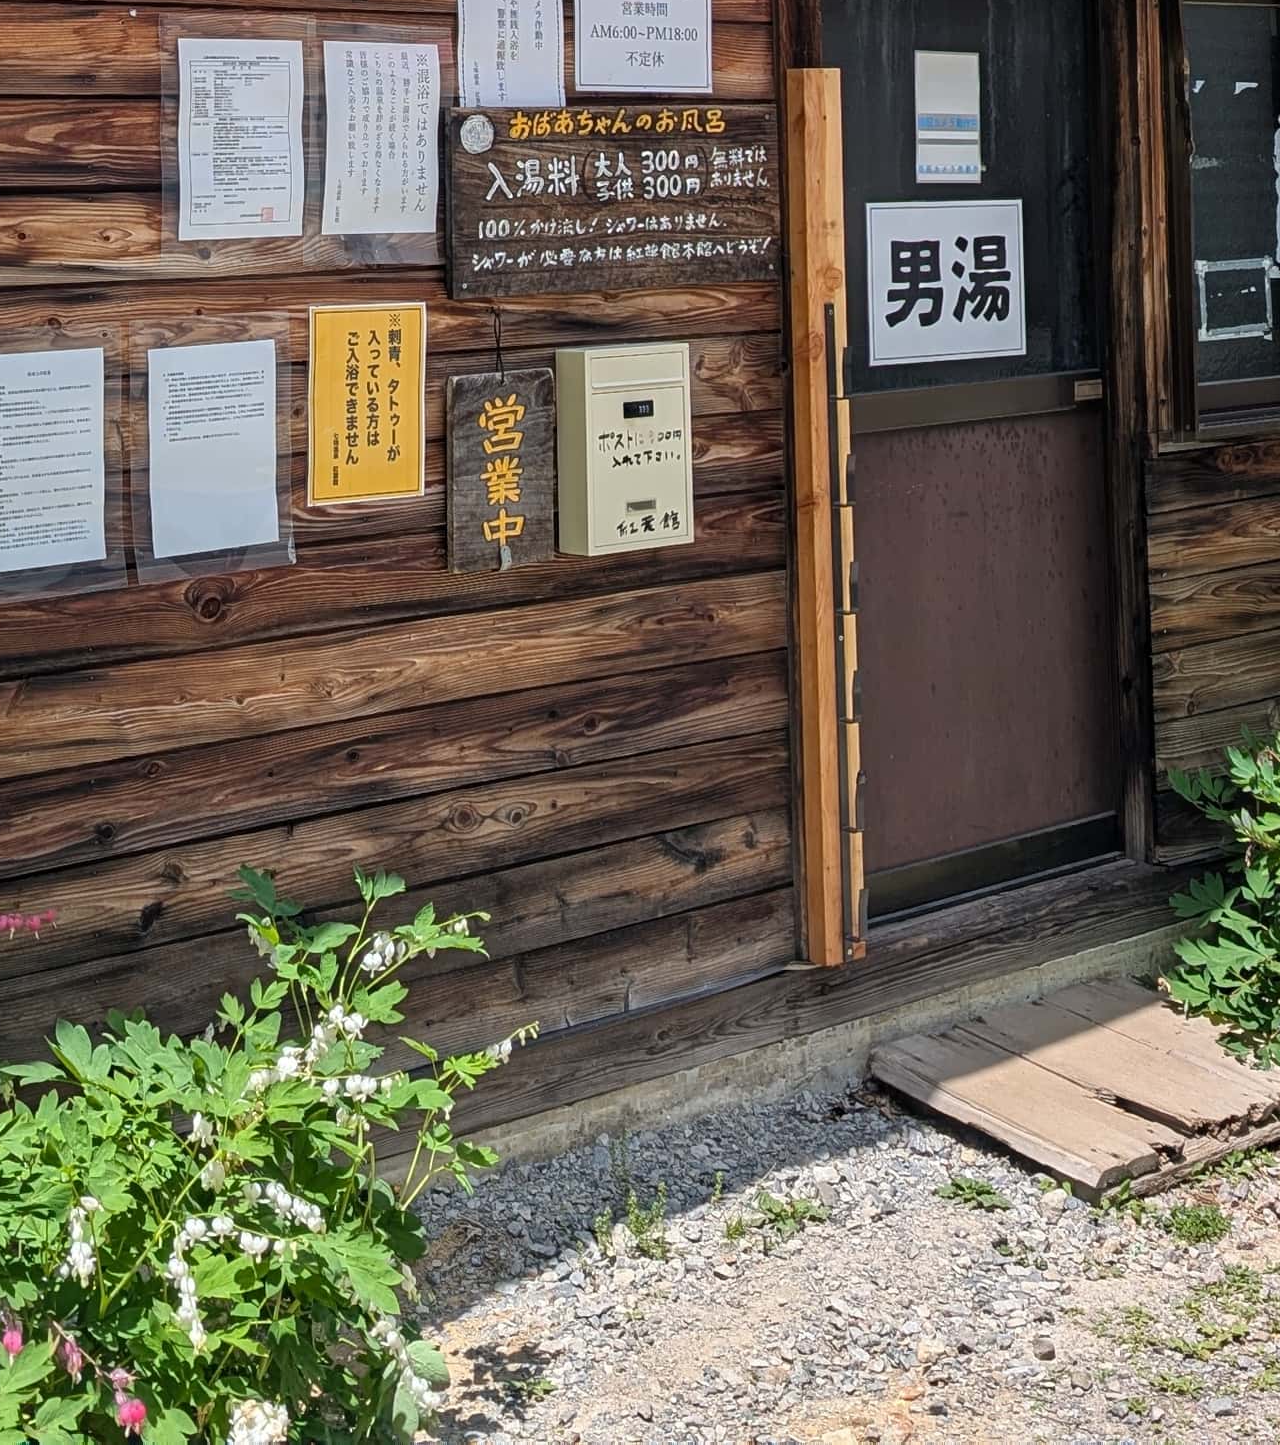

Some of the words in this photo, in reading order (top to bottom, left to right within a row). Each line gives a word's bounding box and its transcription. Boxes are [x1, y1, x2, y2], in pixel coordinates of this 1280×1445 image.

[622, 1, 668, 17] 営業時間
[625, 51, 664, 67] 不定休
[509, 109, 726, 140] おばあちゃんのお風呂
[595, 151, 632, 178] 大人
[710, 145, 767, 169] 無料では
[486, 155, 580, 201] 入湯料
[597, 178, 634, 201] 子供
[885, 235, 1011, 327] 男湯
[345, 331, 360, 465] ご入浴できません
[366, 330, 380, 446] 入っている方は
[479, 394, 526, 546] 営業中
